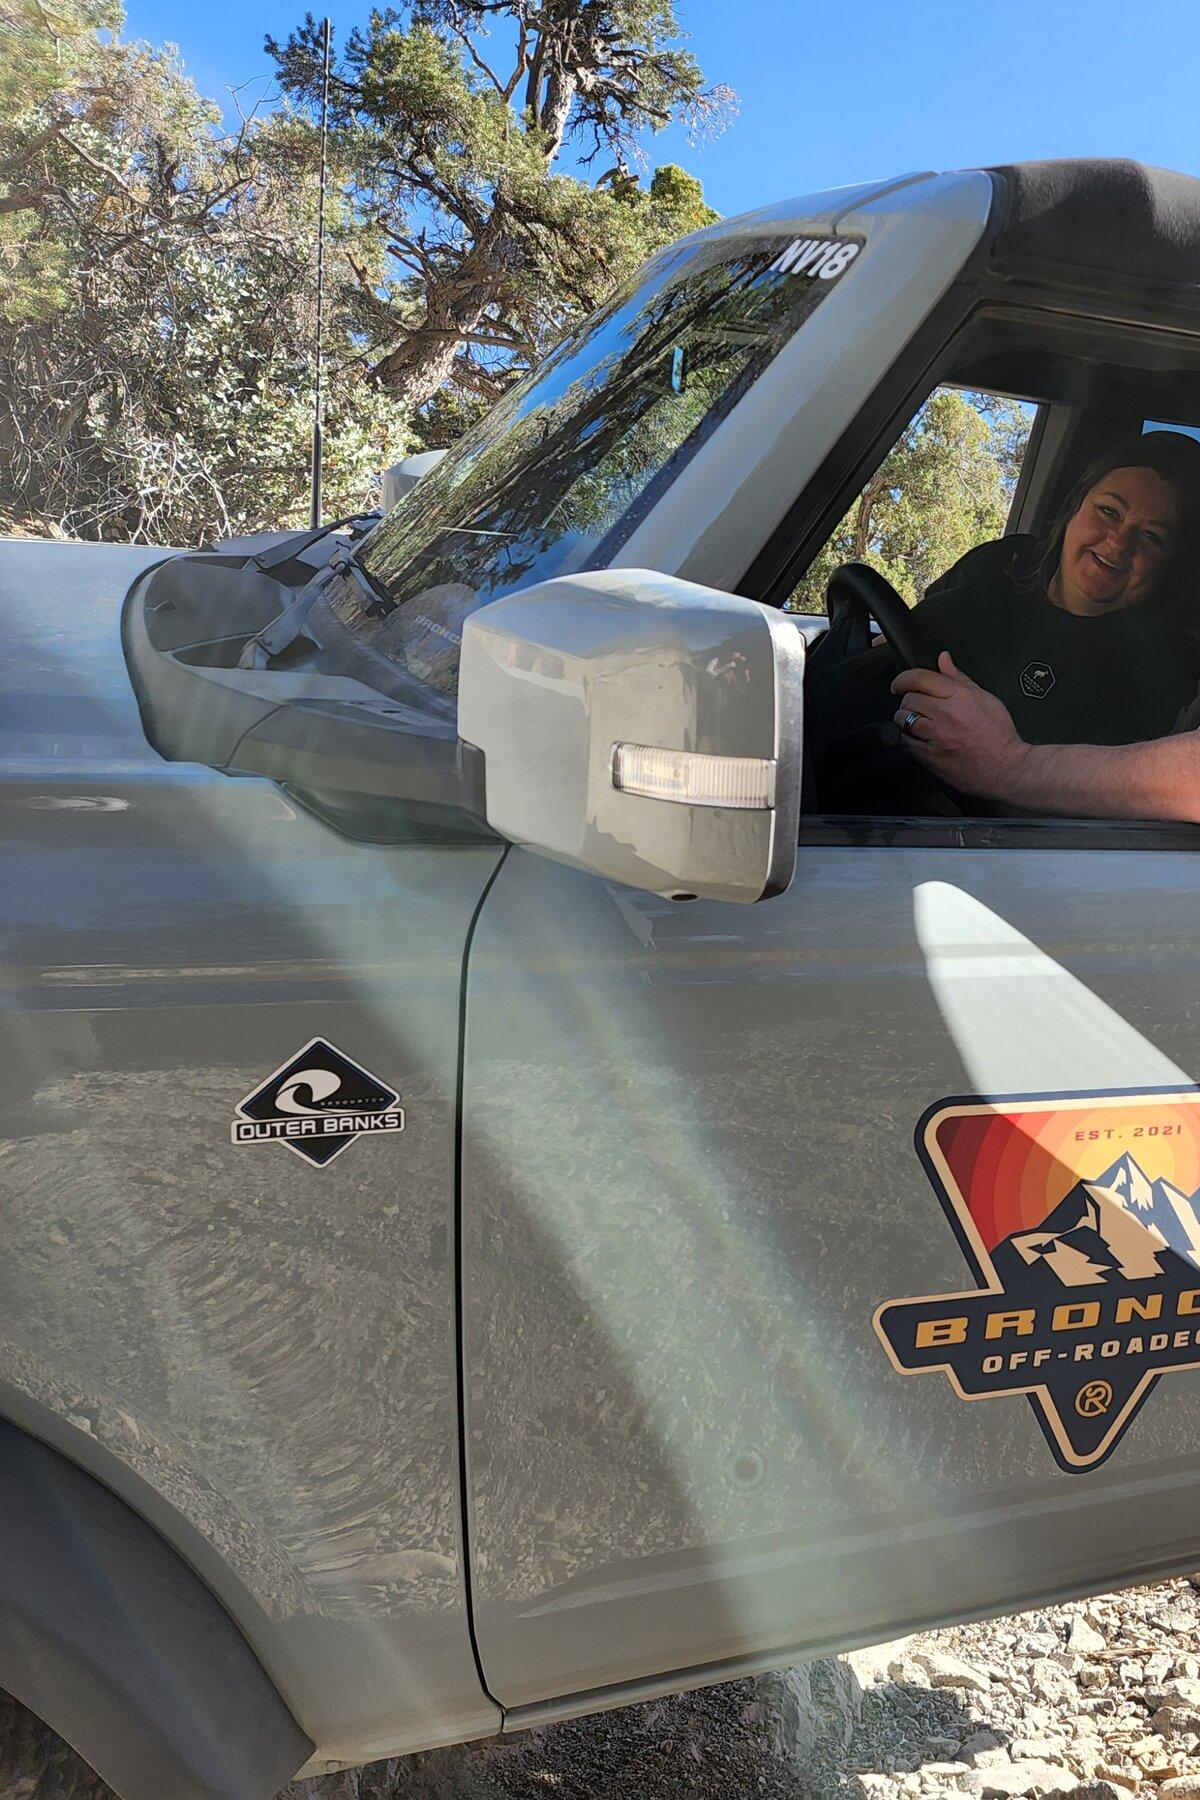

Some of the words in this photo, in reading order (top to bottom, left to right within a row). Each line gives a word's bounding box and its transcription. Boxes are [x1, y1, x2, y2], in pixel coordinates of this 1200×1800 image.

[769, 239, 859, 280] NV18
[239, 1119, 316, 1140] OUTER
[323, 1114, 399, 1133] BANKS
[1074, 1129, 1122, 1141] EST.
[1133, 1125, 1182, 1137] 2021
